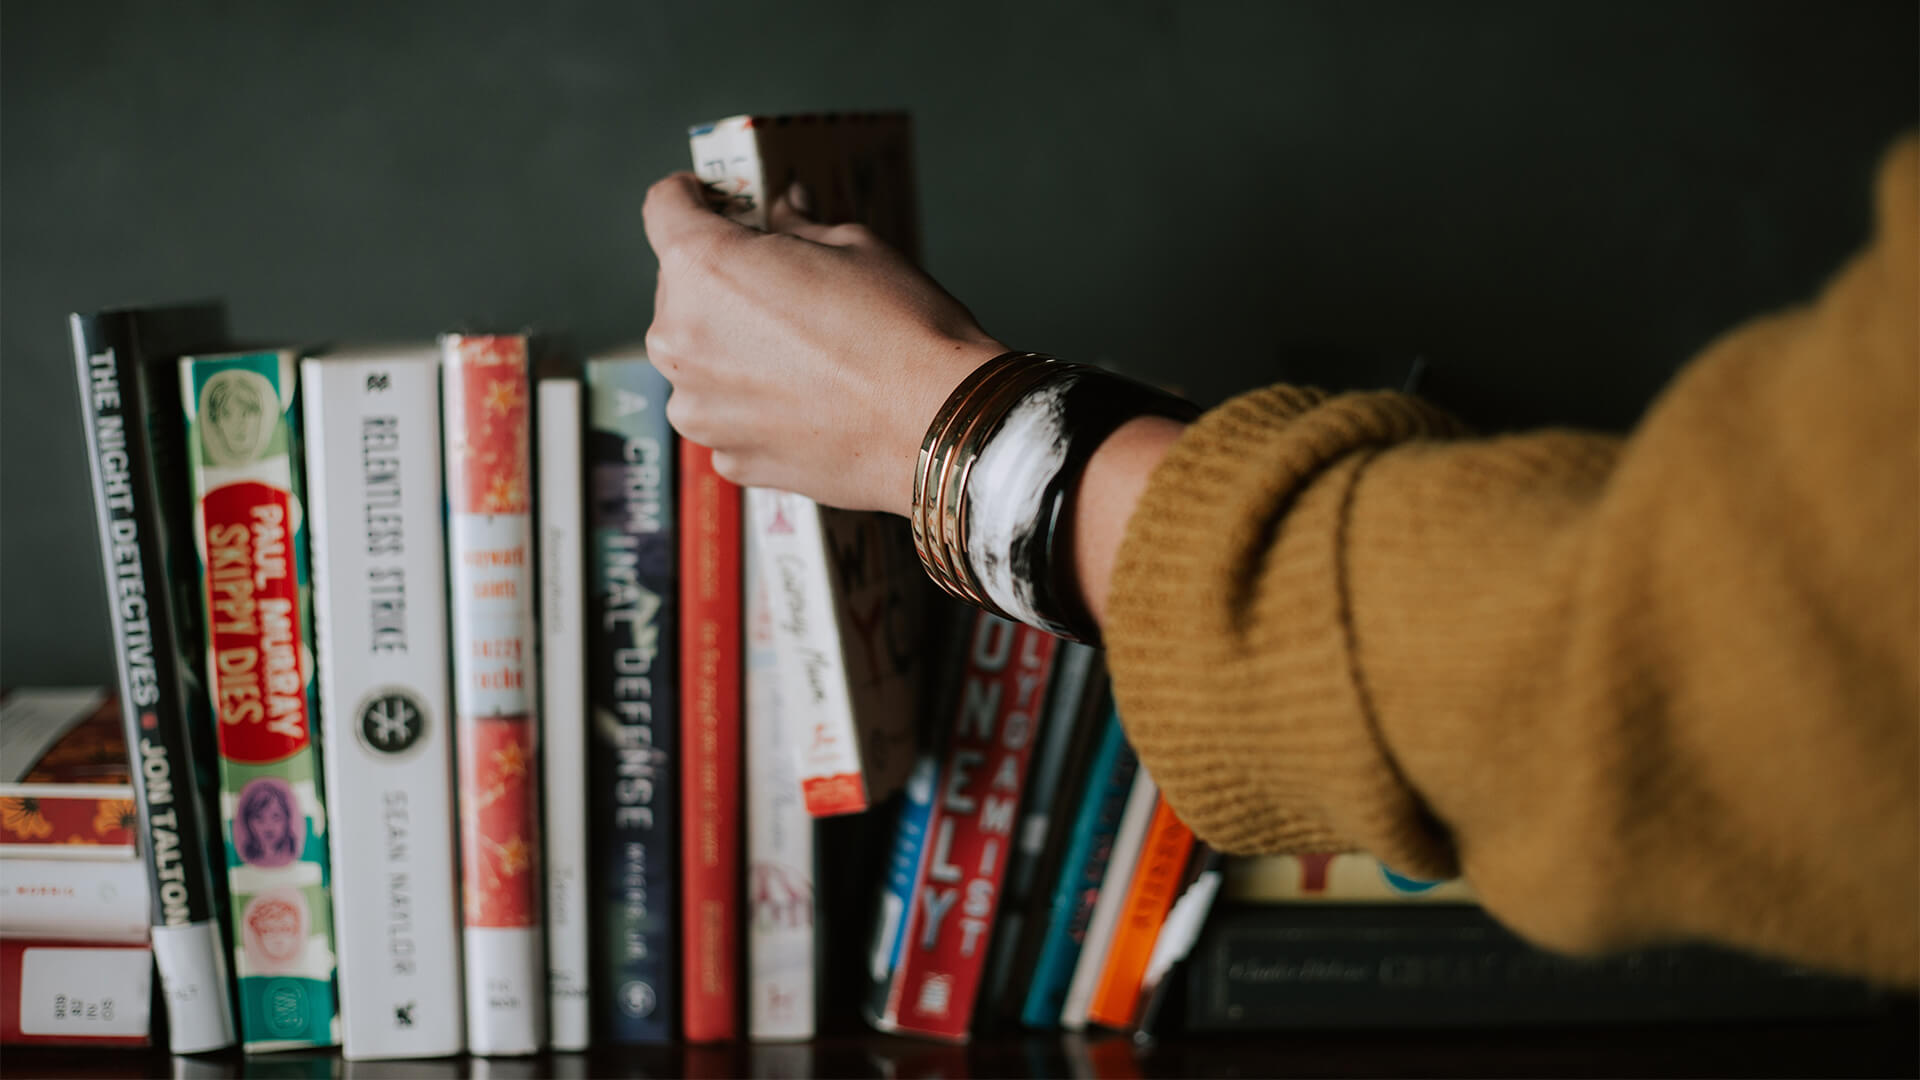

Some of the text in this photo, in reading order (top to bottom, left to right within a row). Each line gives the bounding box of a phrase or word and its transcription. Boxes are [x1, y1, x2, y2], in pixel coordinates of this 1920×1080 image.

[614, 388, 649, 418] A
[90, 347, 160, 708] THE NIGHT DETECTIVES
[208, 522, 264, 726] SKIPPY DIES
[249, 503, 304, 741] PAUL MURRAY
[362, 415, 408, 653] RELENTLESS STRIKE
[141, 737, 192, 927] JON TALTON
[613, 648, 653, 830] DEFENSE
[920, 612, 1018, 952] ONELY
[959, 628, 1042, 957] LYGAMIST
[383, 789, 417, 976] SEAN NAYLOR
